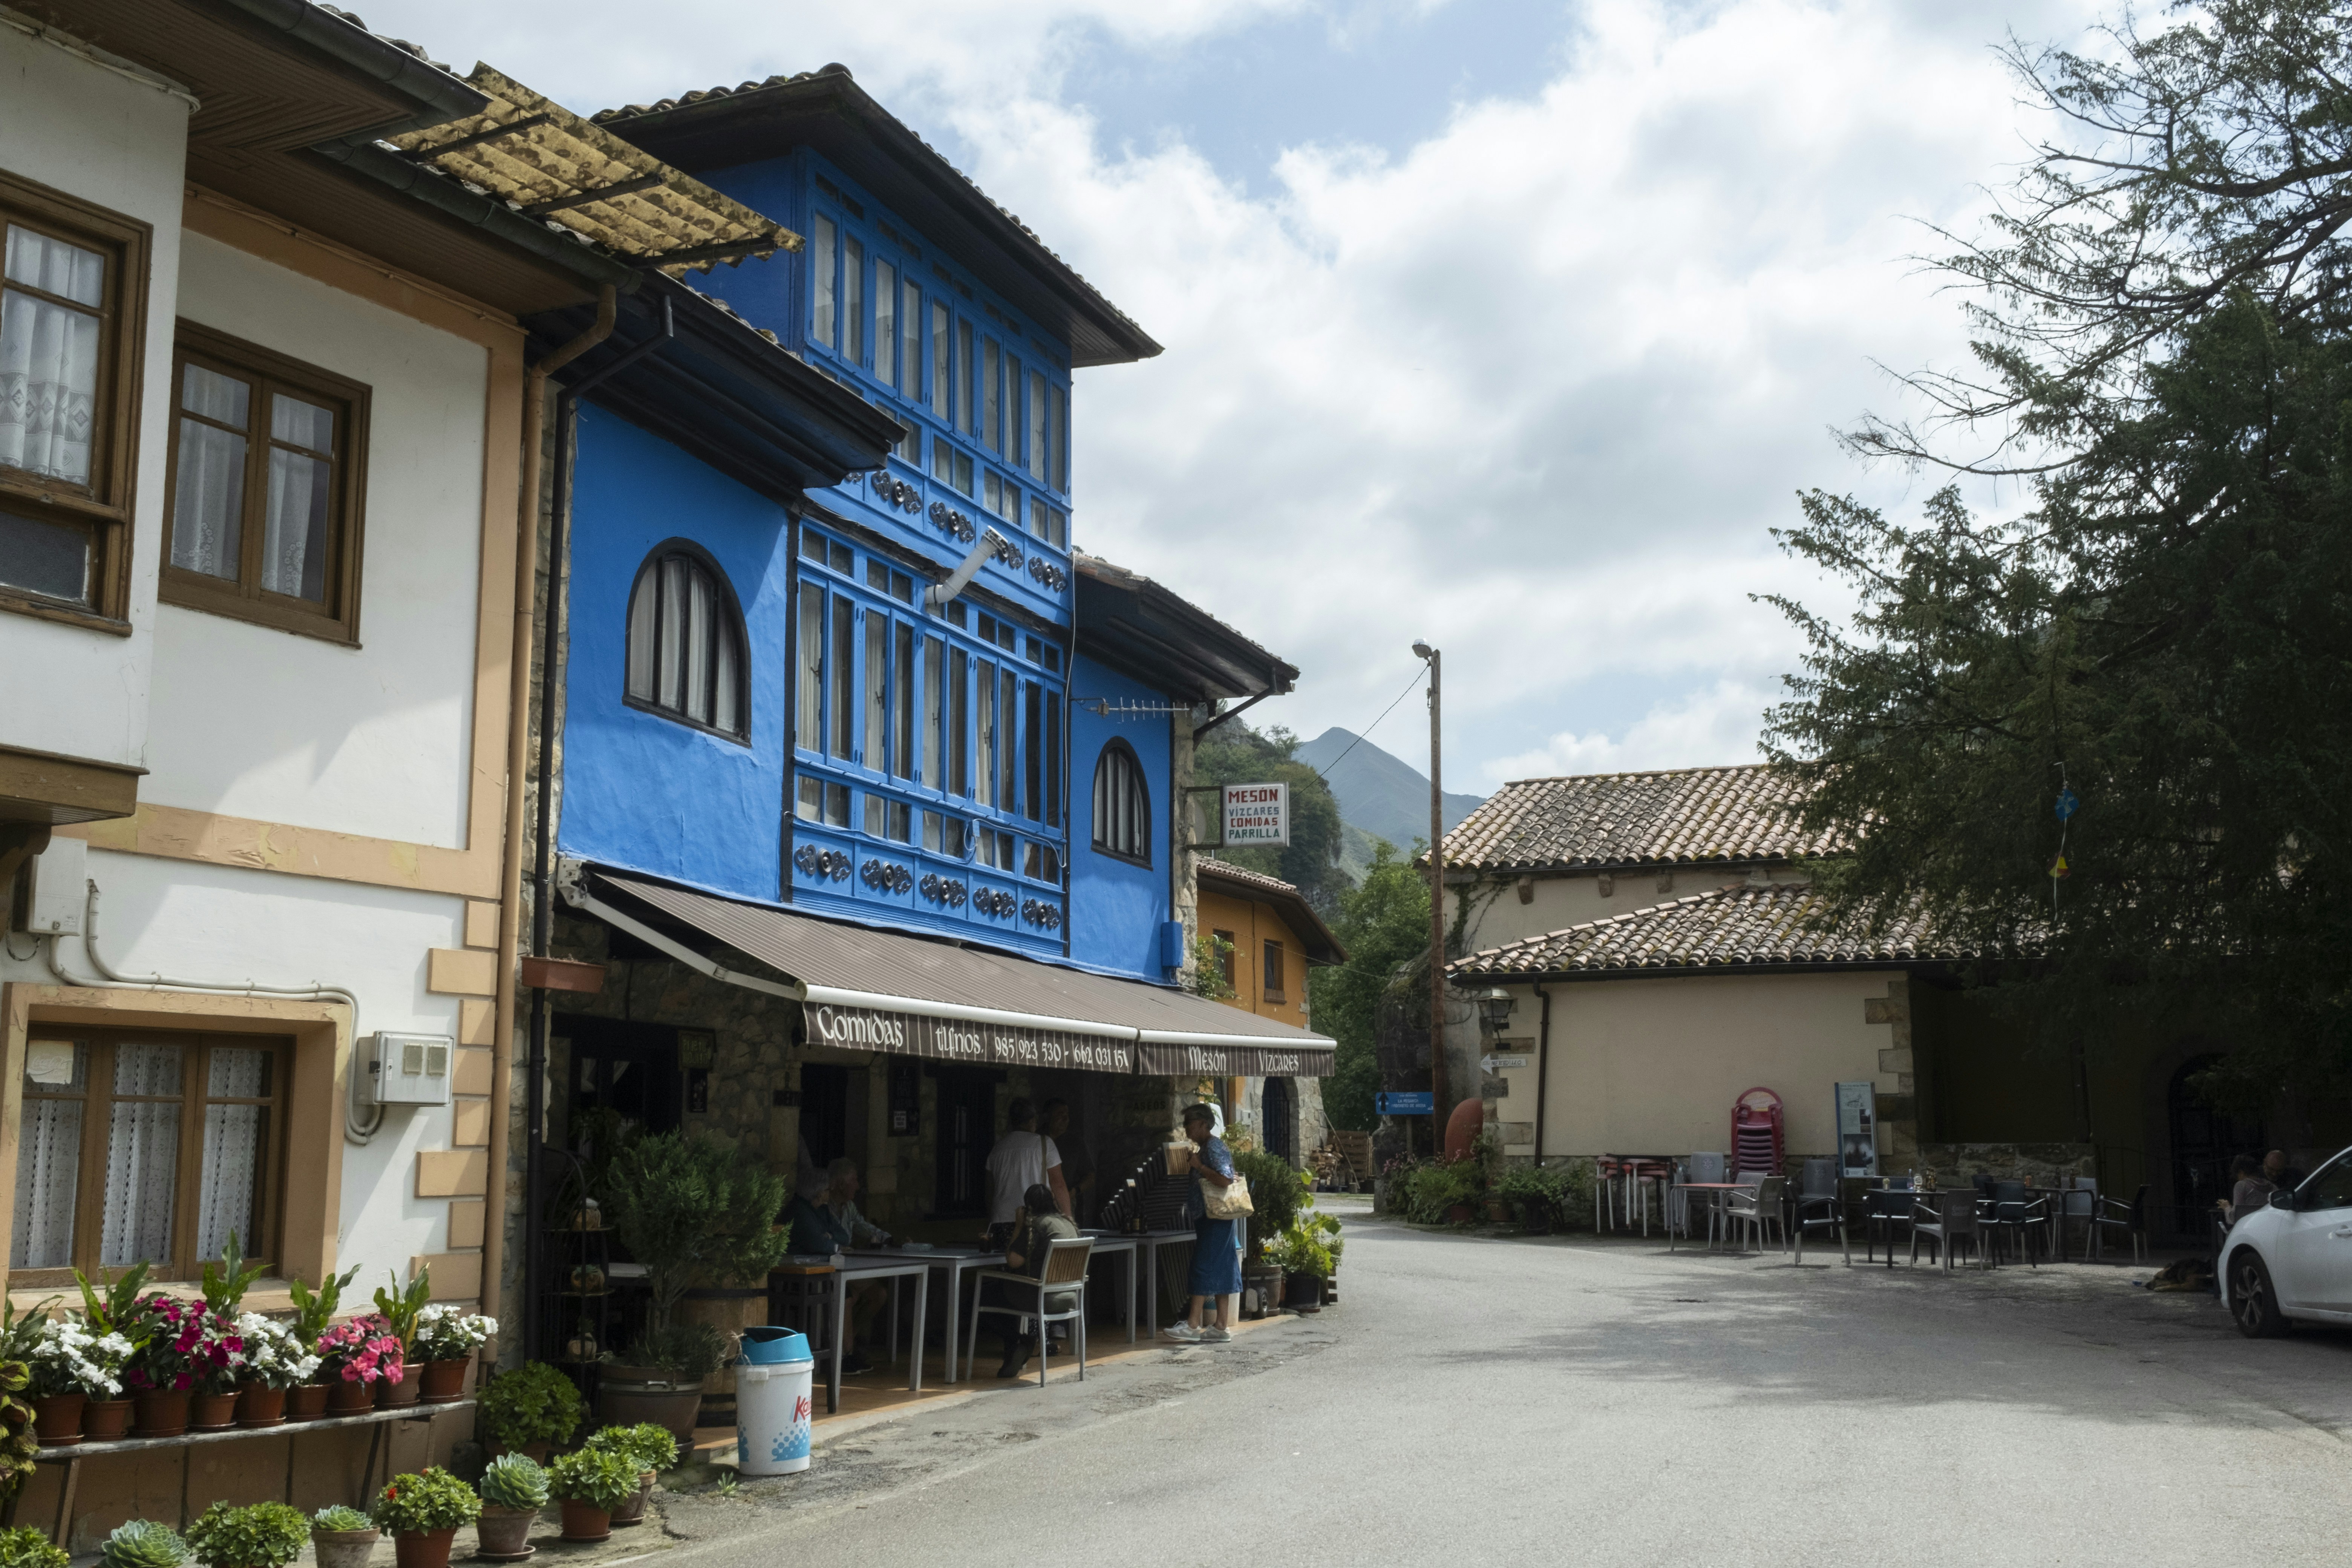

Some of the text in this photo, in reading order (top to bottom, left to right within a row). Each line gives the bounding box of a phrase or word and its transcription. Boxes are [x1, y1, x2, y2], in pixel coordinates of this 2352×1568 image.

[1228, 787, 1278, 803] MESÓN
[1228, 806, 1279, 817] VÍZCARES
[1230, 816, 1278, 828] COMIDAS
[1228, 828, 1280, 839] PARRILLA
[817, 1006, 903, 1047] Comidas
[995, 1037, 1015, 1058] 985
[1019, 1040, 1037, 1060] 923
[1042, 1042, 1061, 1062] 530
[1074, 1044, 1092, 1064] 662
[1096, 1047, 1112, 1065] 031
[1113, 1049, 1129, 1068] 151
[1133, 1101, 1165, 1111] ASEOS
